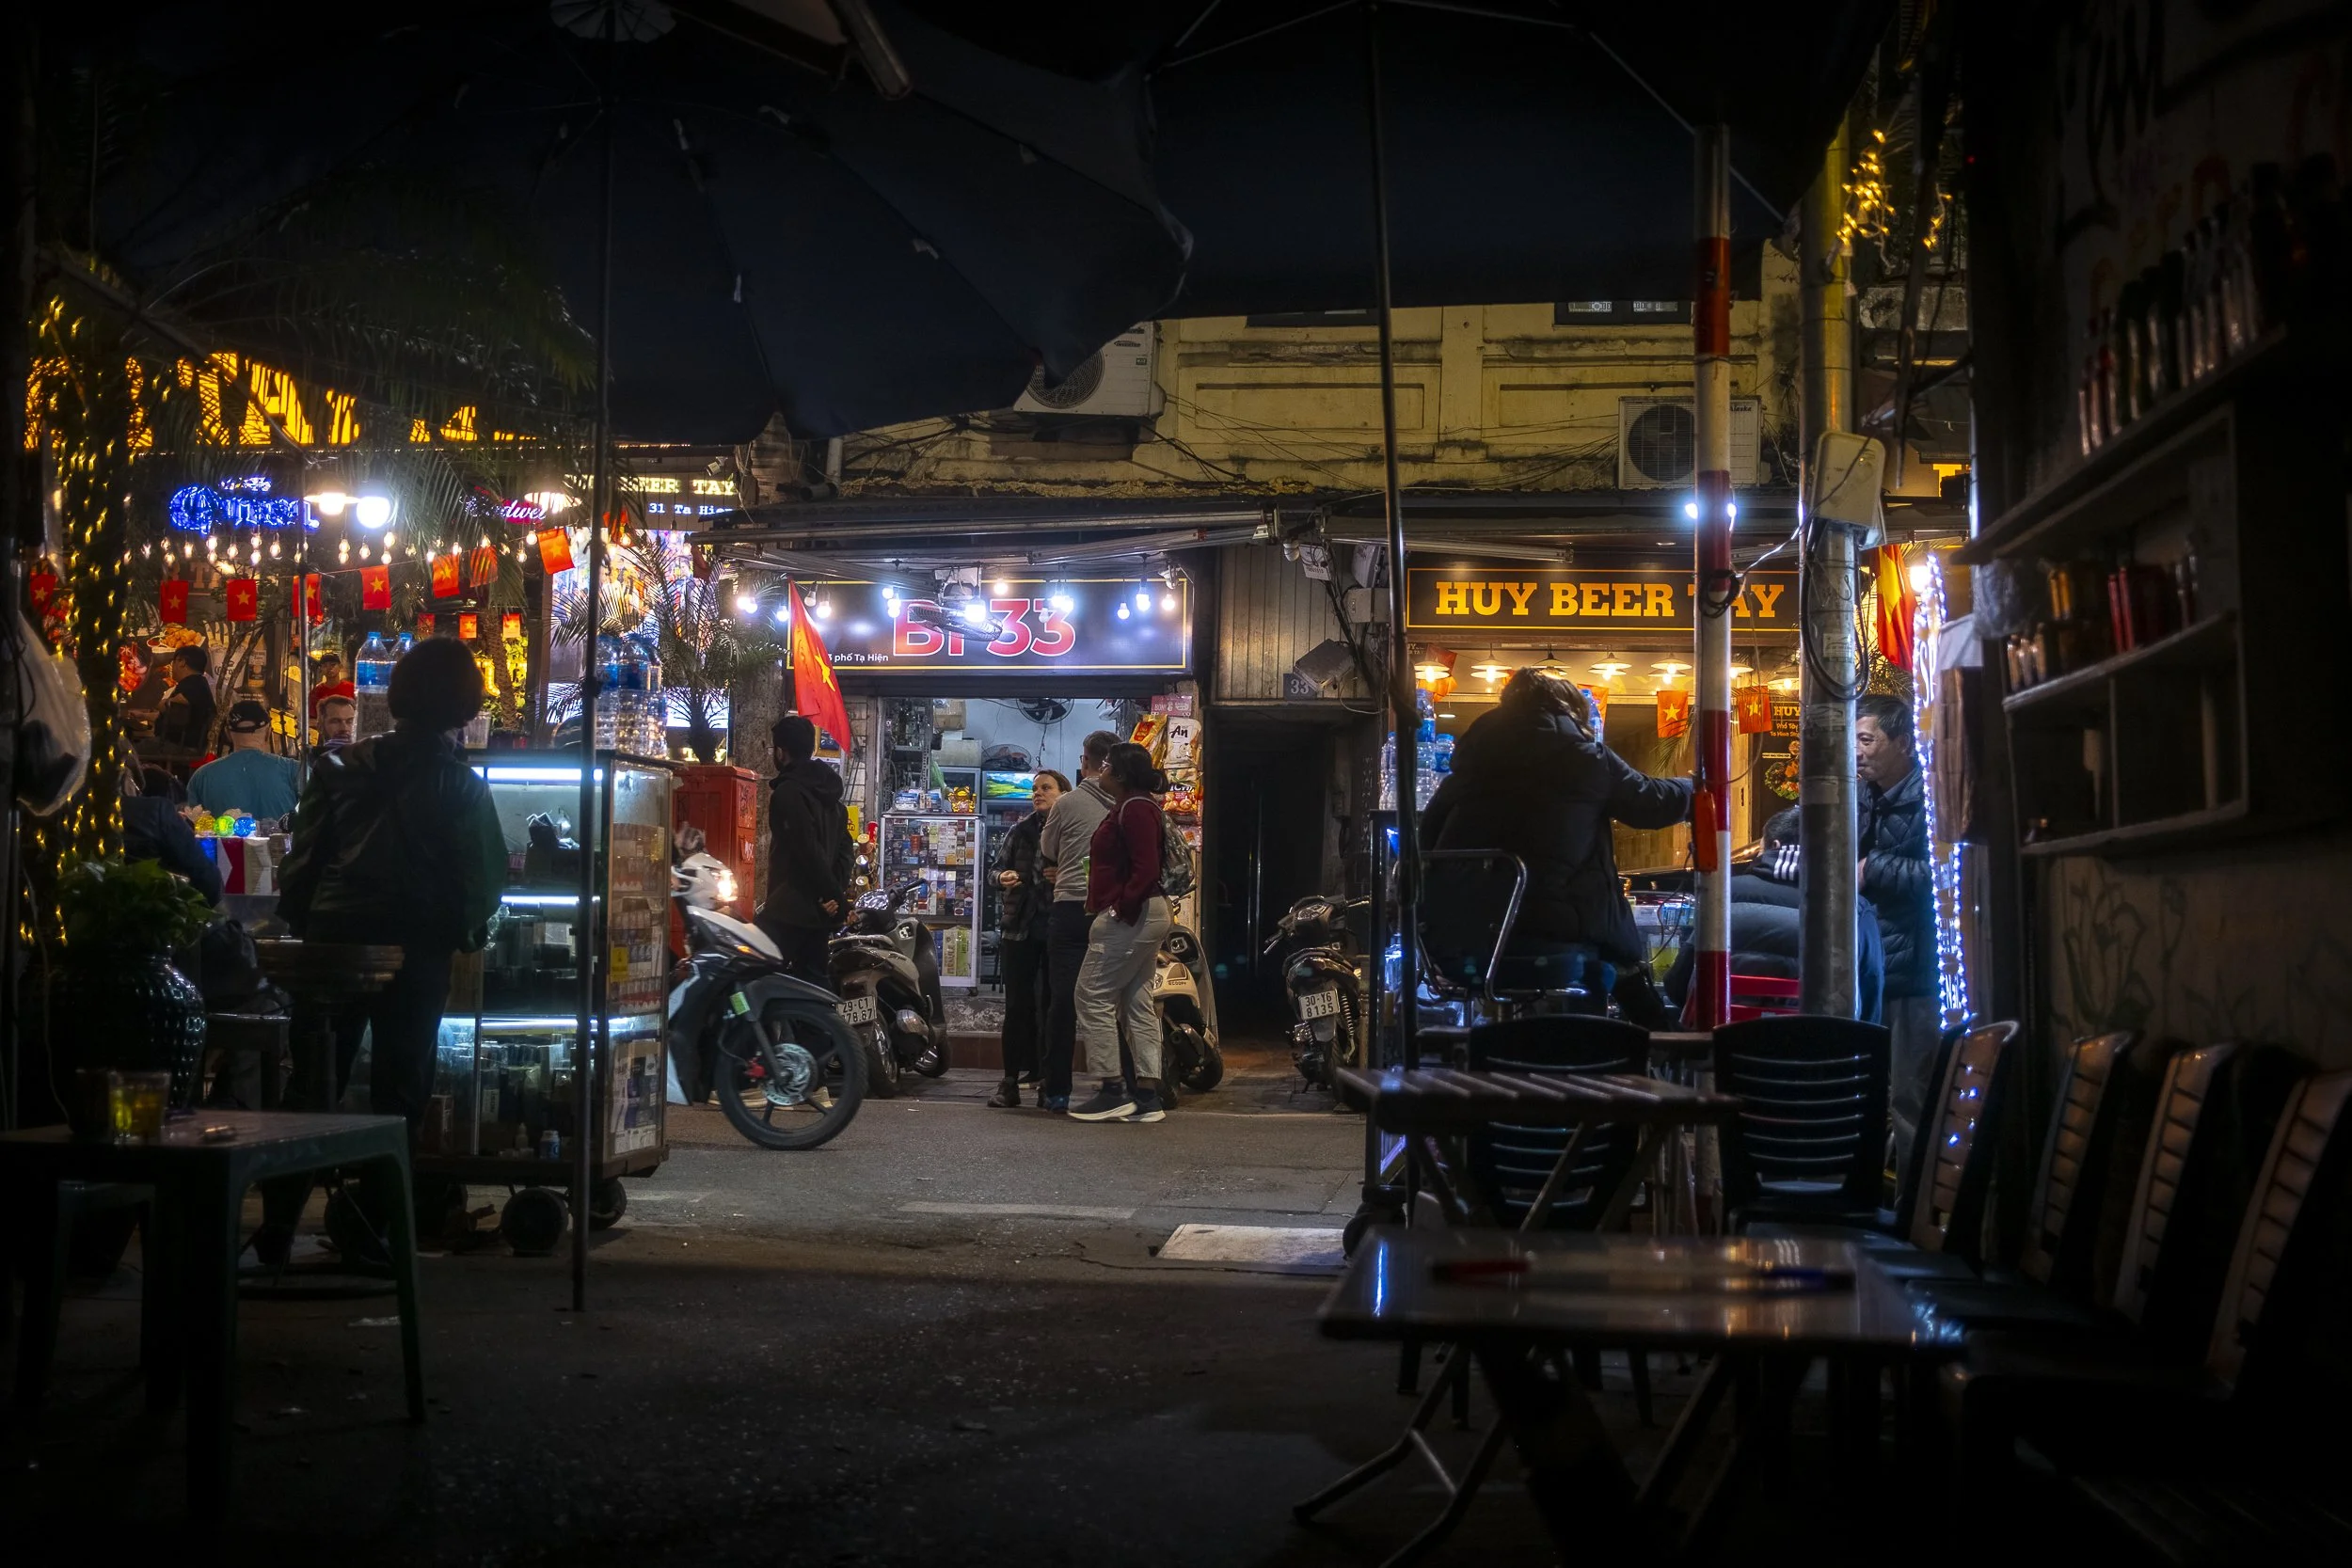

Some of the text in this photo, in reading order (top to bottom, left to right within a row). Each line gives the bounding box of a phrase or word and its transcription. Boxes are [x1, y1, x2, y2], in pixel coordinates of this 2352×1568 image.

[649, 503, 734, 515] 31 Ta Hie
[1436, 581, 1785, 618] HUY BEER AY
[986, 598, 1077, 657] 33
[834, 653, 853, 663] phố
[854, 654, 866, 663] Tạ
[867, 653, 889, 663] Hiện
[1290, 678, 1310, 694] 33
[1773, 705, 1801, 717] HUY
[1169, 724, 1188, 738] An
[843, 998, 868, 1013] 29-C1
[1305, 992, 1332, 1006] 30-Y6
[1306, 1003, 1334, 1017] 8135
